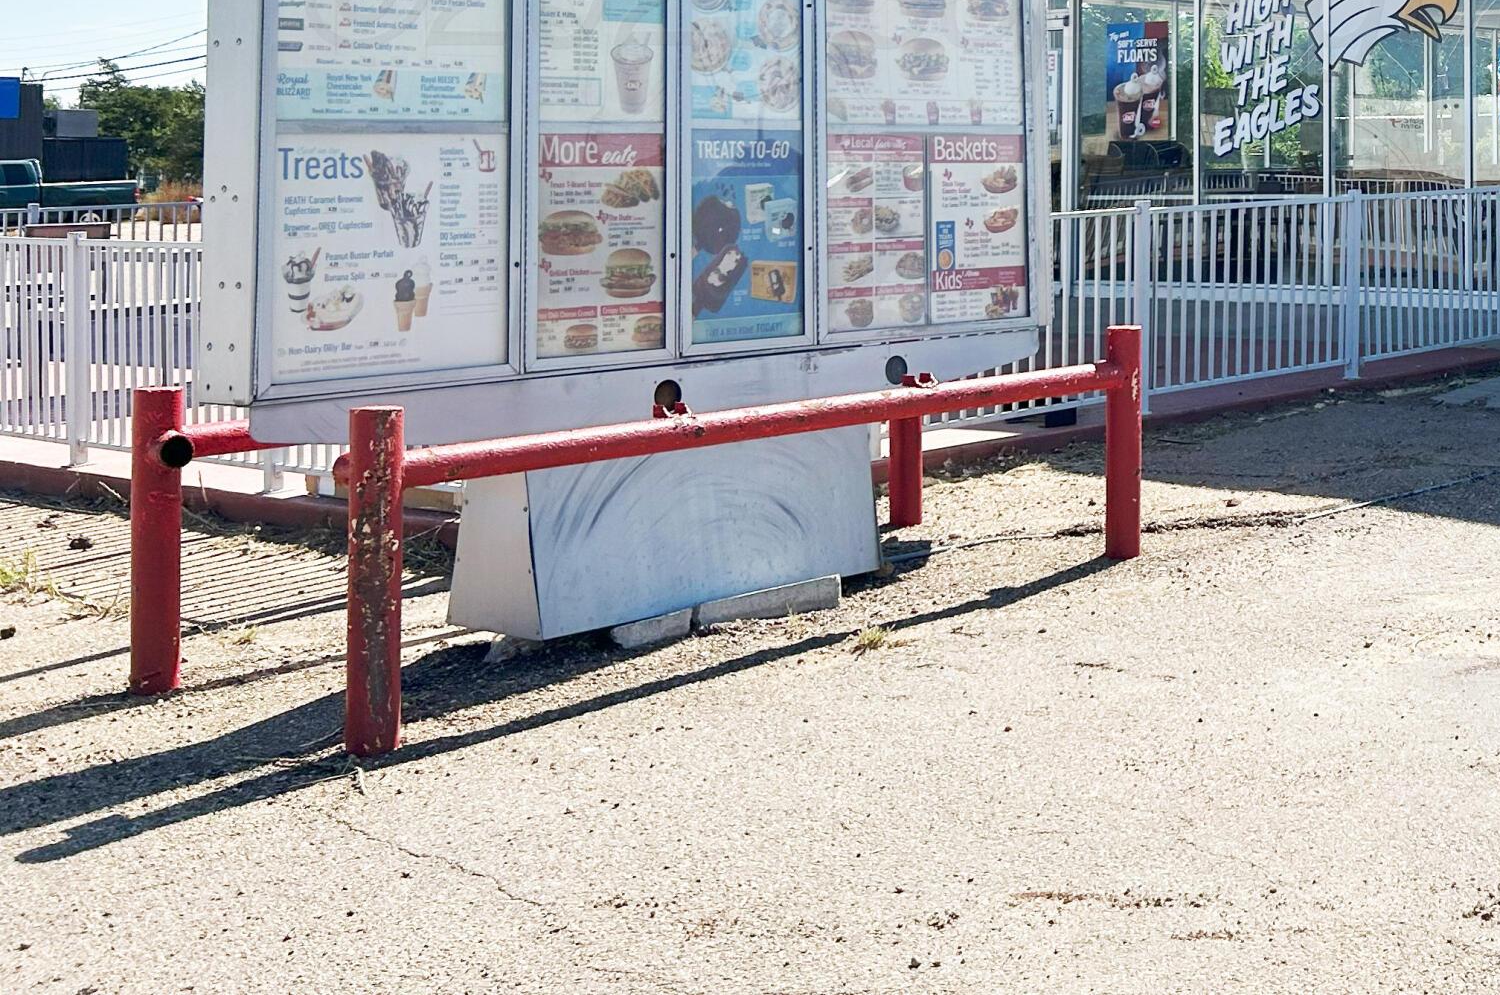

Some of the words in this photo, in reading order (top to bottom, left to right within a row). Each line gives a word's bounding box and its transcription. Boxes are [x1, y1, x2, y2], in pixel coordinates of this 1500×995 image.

[1117, 48, 1158, 63] FLOATS
[1221, 13, 1294, 74] WITH
[1234, 55, 1291, 106] THE
[1214, 84, 1320, 157] EAGLES
[278, 148, 364, 180] Treats
[540, 135, 598, 164] More
[601, 145, 637, 167] eats
[697, 140, 745, 159] TREATS
[749, 140, 790, 159] TO-GO
[934, 136, 998, 161] Baskets
